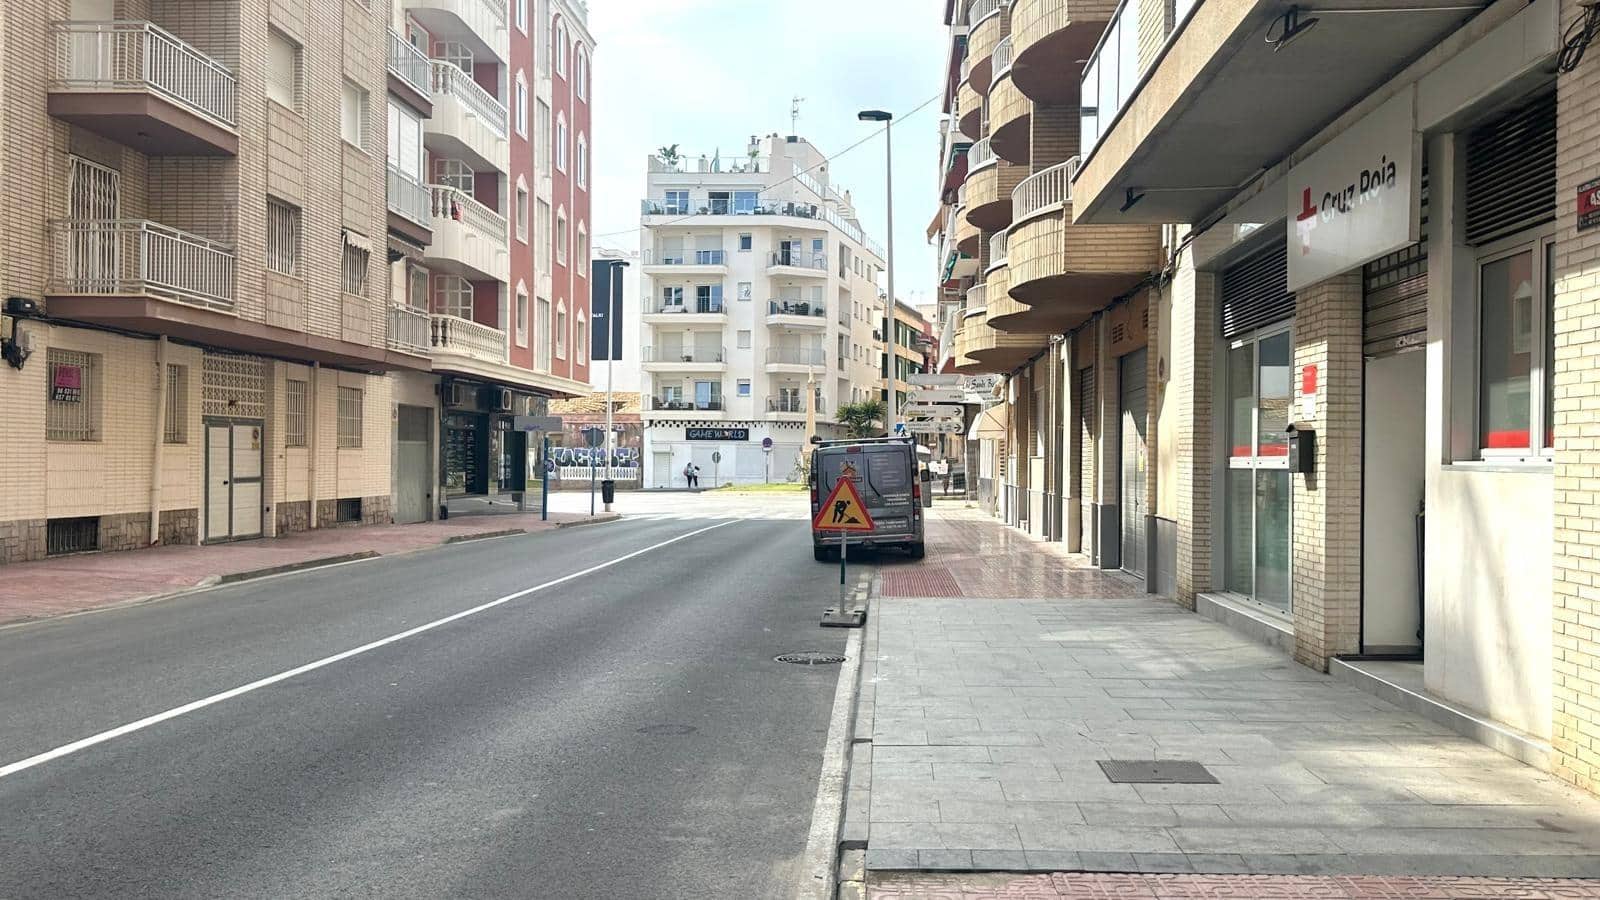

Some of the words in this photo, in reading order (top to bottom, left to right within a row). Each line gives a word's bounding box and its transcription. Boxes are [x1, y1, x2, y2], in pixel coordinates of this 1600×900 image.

[1321, 184, 1355, 223] Cruz
[1360, 154, 1396, 205] Roja
[689, 430, 713, 439] GAME
